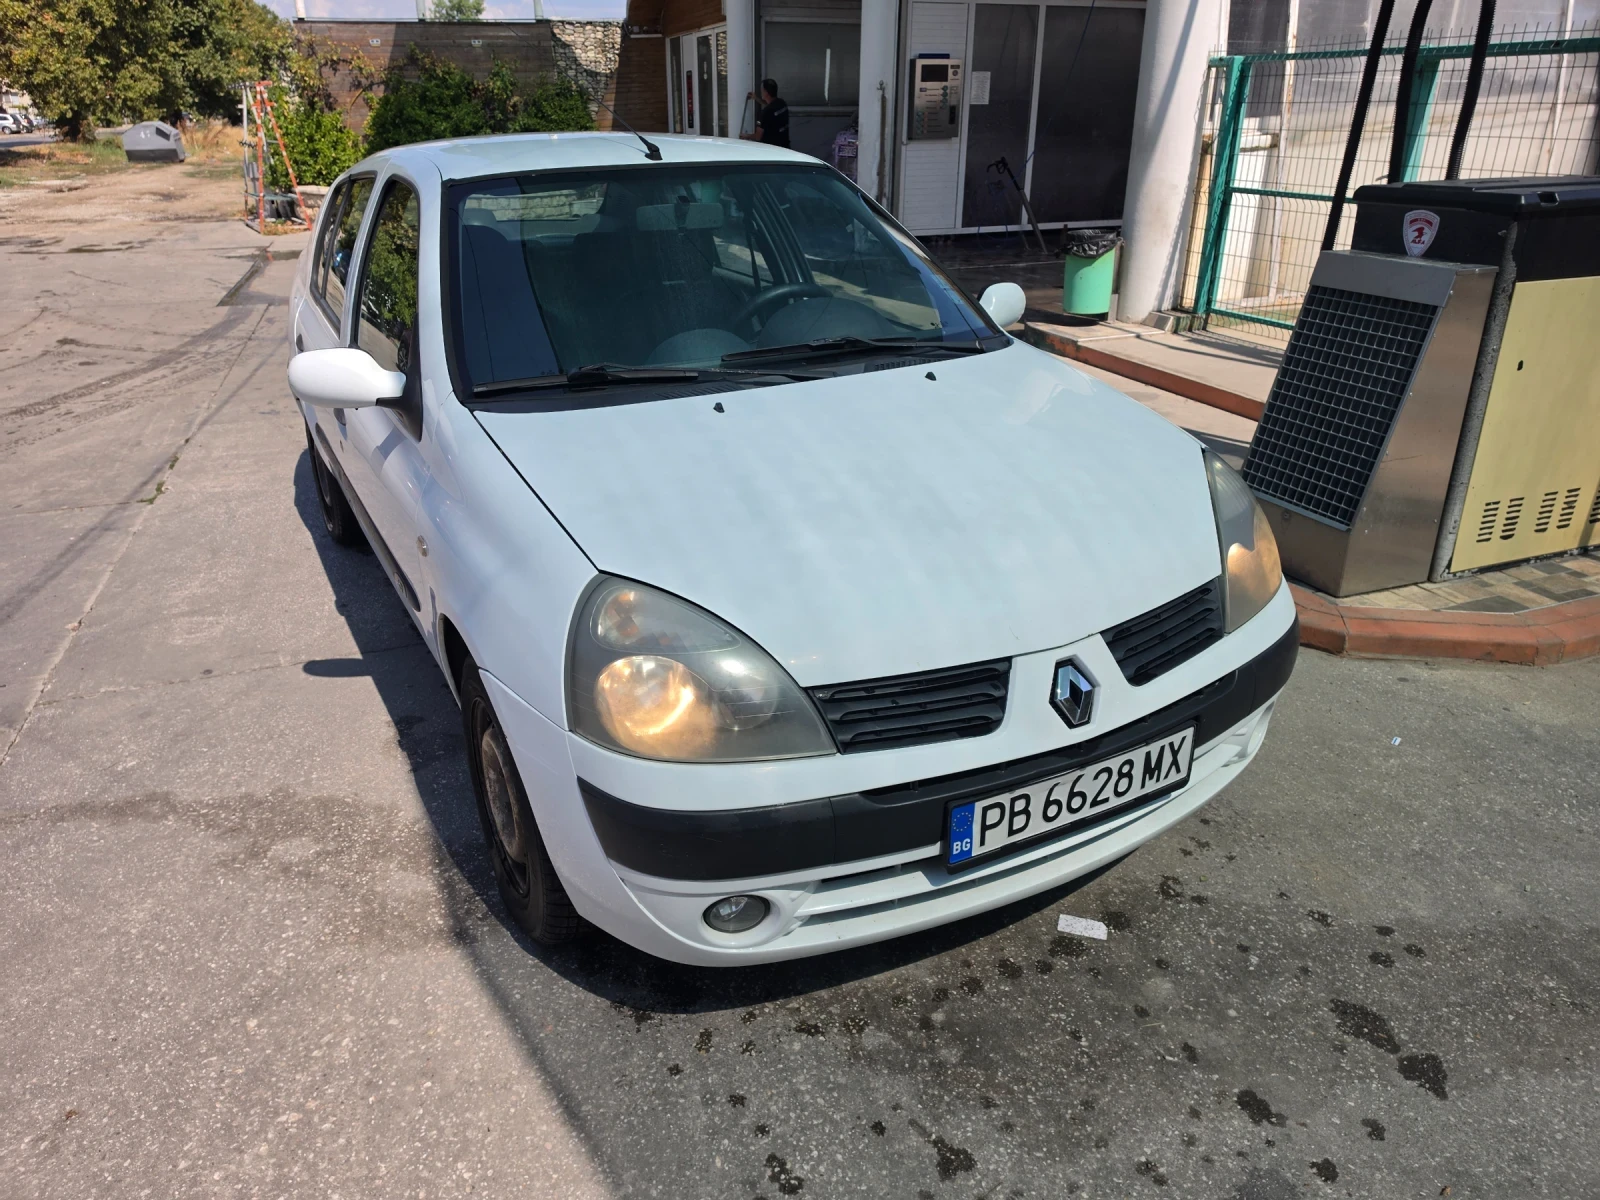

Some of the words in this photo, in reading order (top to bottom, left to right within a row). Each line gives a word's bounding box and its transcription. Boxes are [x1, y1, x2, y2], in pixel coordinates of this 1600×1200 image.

[979, 793, 1031, 847] PB
[1042, 758, 1135, 823] 6628
[1140, 735, 1188, 790] MX
[952, 838, 971, 855] BG
